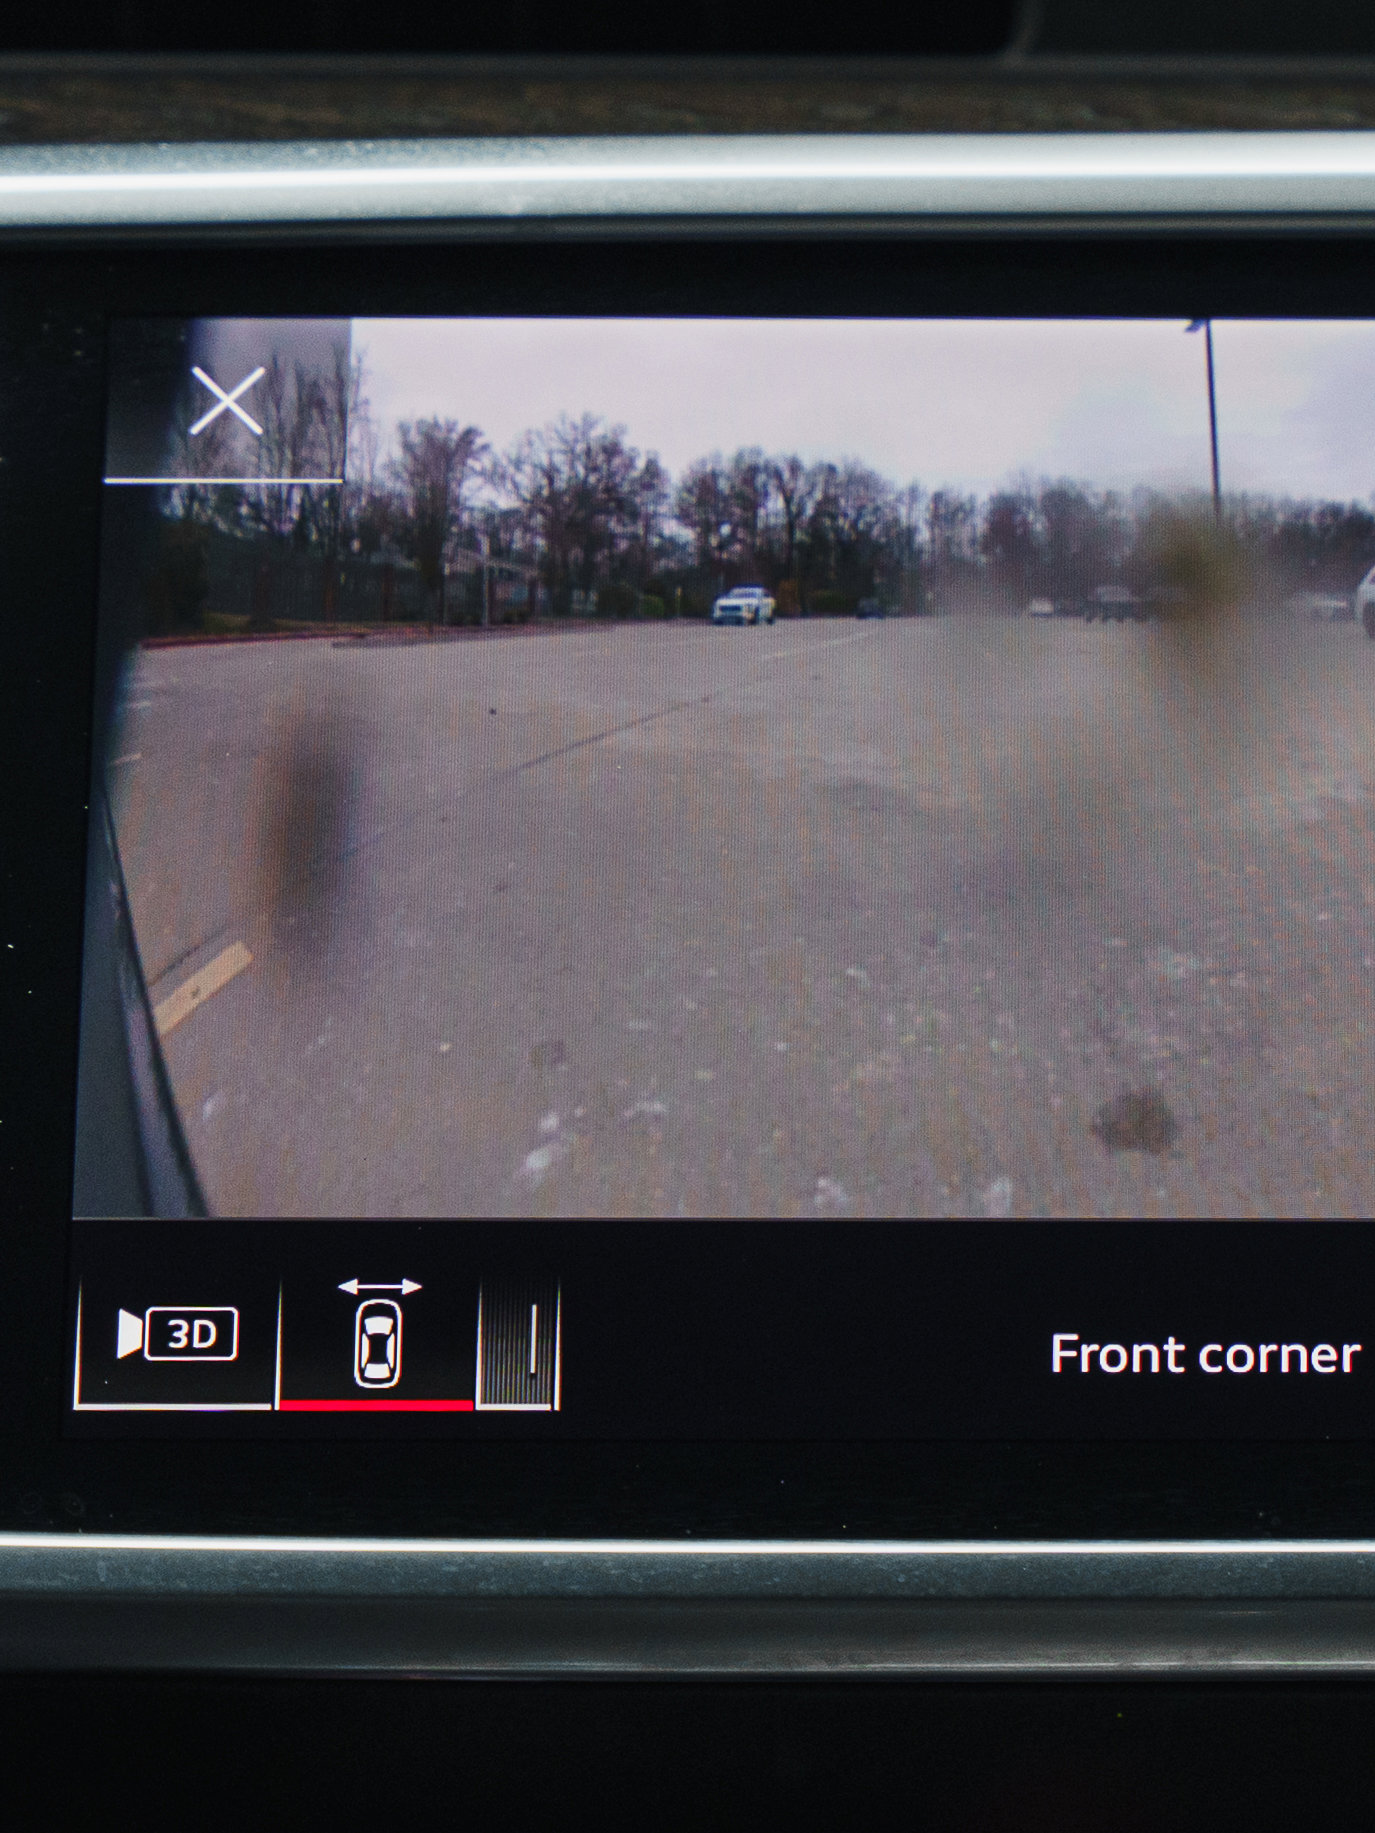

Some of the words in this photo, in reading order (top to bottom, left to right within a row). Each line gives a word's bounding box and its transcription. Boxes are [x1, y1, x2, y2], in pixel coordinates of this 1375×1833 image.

[167, 1319, 217, 1349] 3D
[1051, 1333, 1186, 1374] Front
[1198, 1343, 1362, 1373] corner
